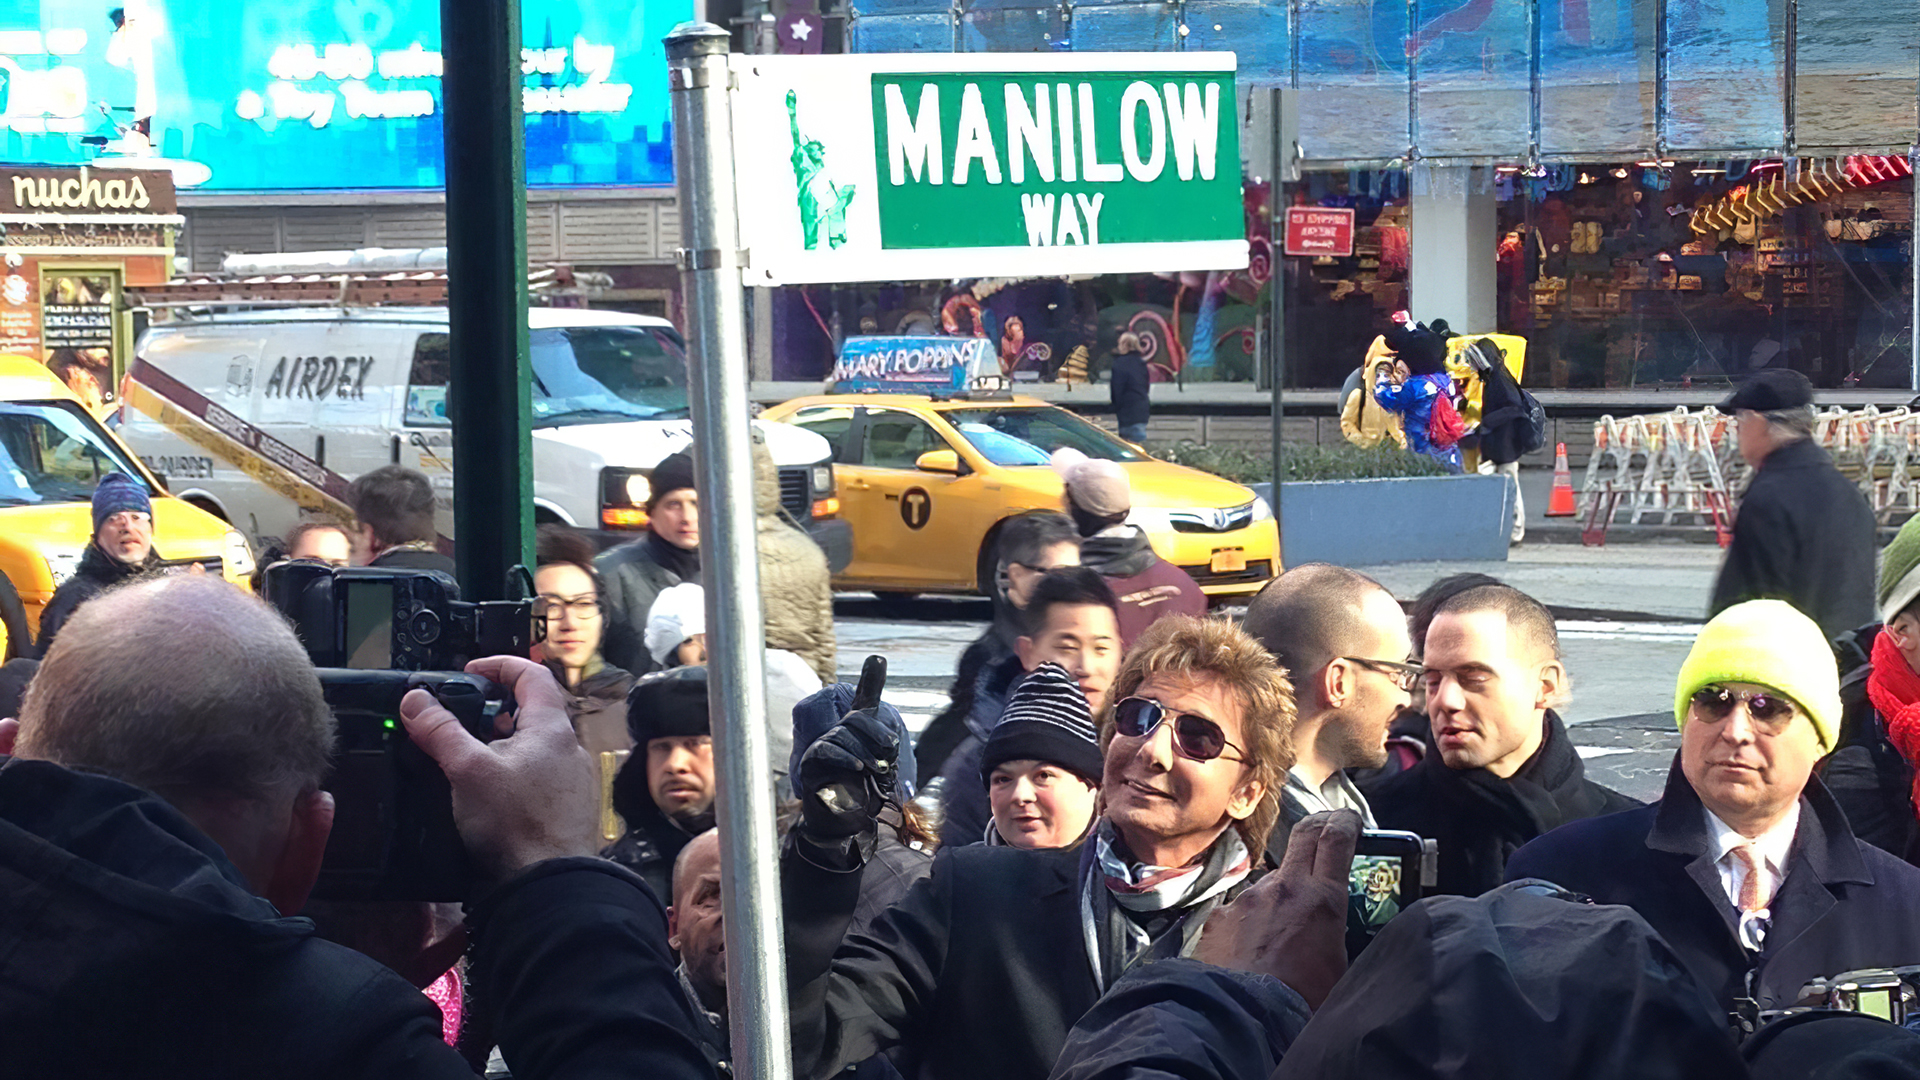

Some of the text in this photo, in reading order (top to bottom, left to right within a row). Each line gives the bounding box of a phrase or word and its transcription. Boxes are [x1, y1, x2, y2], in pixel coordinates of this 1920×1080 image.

[884, 80, 1220, 186] MANILOW
[11, 166, 150, 209] nuchas
[1021, 192, 1105, 247] WAY
[264, 356, 375, 401] AIRDEX
[832, 350, 893, 382] MARY
[907, 494, 925, 525] T
